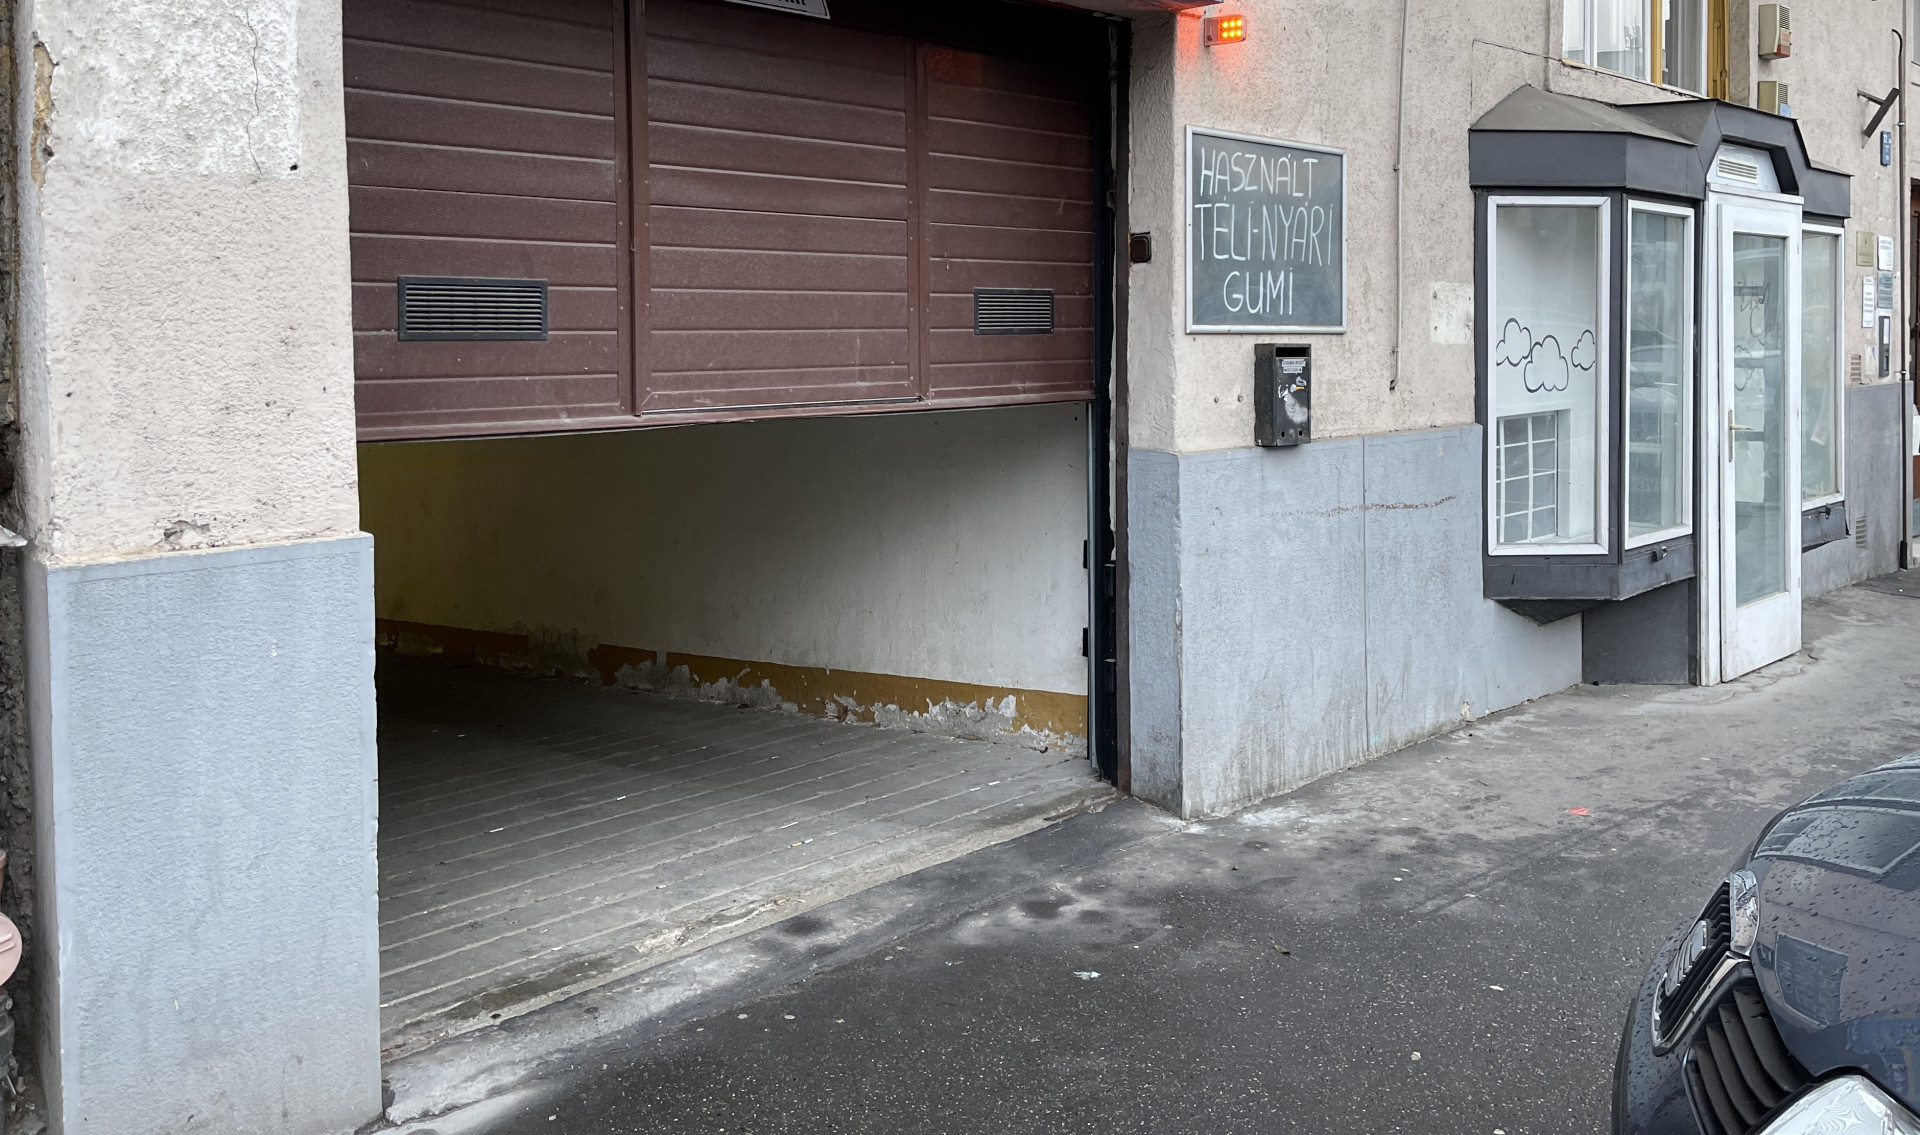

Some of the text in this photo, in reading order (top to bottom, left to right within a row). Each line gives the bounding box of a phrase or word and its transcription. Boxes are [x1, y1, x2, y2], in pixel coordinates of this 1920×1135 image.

[1200, 146, 1319, 199] HASZNÁLT
[1194, 196, 1334, 266] TÉLI-NYÁRI
[1223, 267, 1294, 316] GUMI
